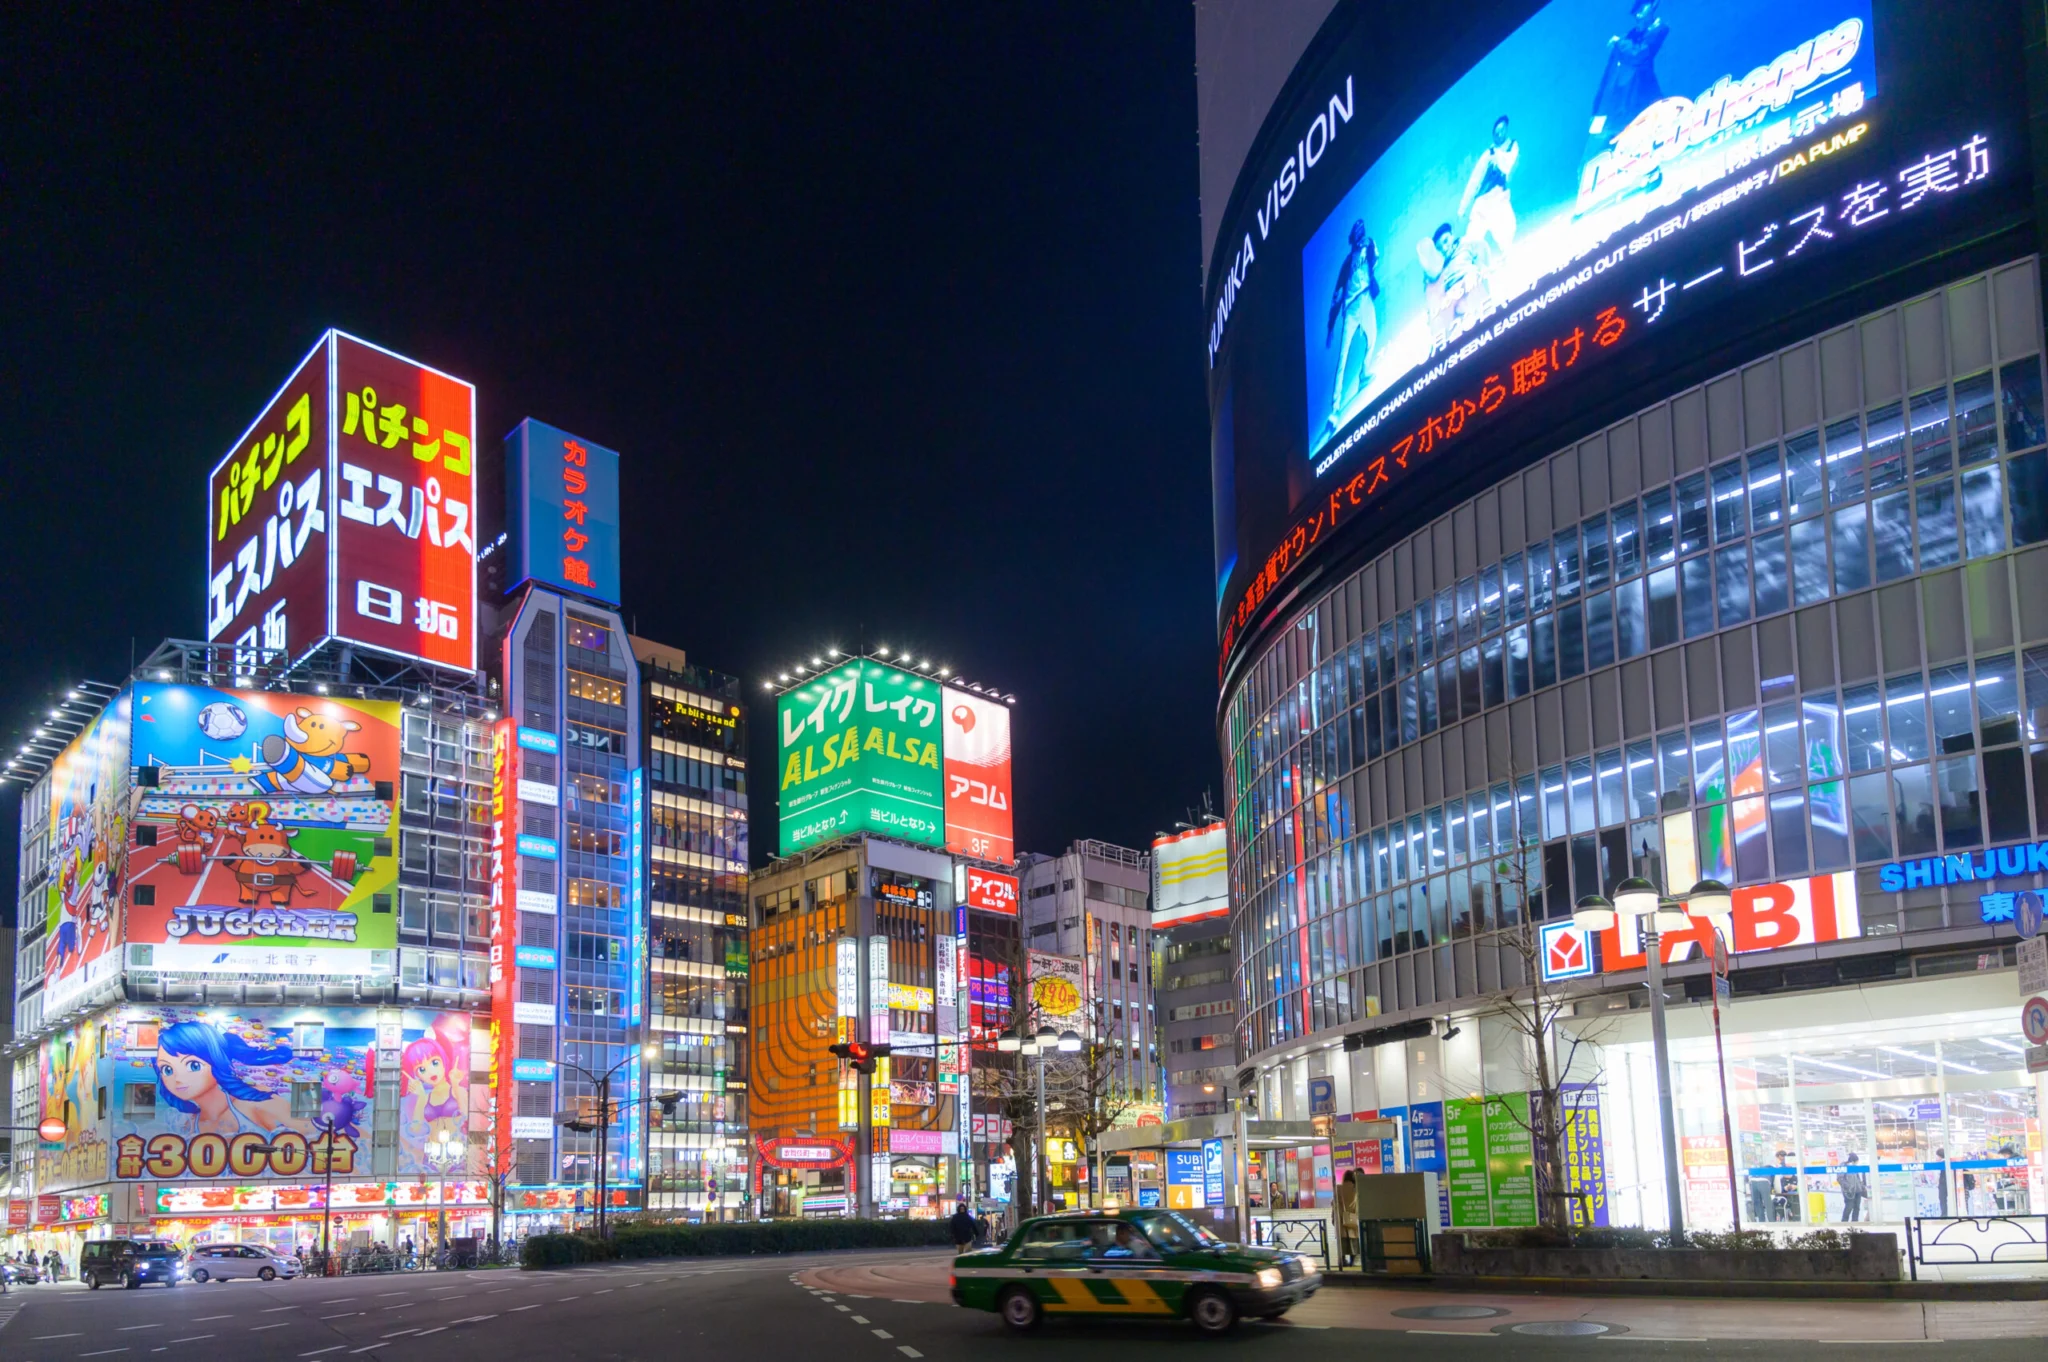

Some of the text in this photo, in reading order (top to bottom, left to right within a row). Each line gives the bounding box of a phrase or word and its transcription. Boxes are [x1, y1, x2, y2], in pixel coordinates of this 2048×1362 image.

[1593, 249, 1627, 274] OUT
[1808, 122, 1868, 163] PUMP
[1207, 75, 1354, 369] YUNIKA VISION
[342, 386, 471, 476] パチンコ
[218, 392, 311, 541] パチンコ
[340, 463, 473, 554] エスパス
[210, 468, 325, 640] エスパス
[675, 702, 736, 728] Public stand
[783, 679, 857, 748] レイク
[864, 681, 936, 729] レイク
[782, 725, 860, 791] ALSA
[863, 726, 939, 770] ALSA
[493, 731, 506, 816] パチンコ
[949, 774, 1007, 811] アコム
[792, 817, 837, 842] 当ビルとなり
[870, 807, 926, 831] 当ビルとなり
[971, 837, 990, 854] 3F
[490, 820, 504, 939] エスパス
[969, 875, 1015, 900] アイフル
[166, 905, 358, 942] JUGGLER
[1599, 874, 1842, 973] LABI
[264, 953, 319, 967] 北電子
[971, 982, 1009, 996] PROMISE
[1311, 1080, 1331, 1113] P
[1446, 1105, 1461, 1120] 5F
[1486, 1102, 1502, 1117] 6F
[972, 1118, 1013, 1134] アコム
[1411, 1109, 1424, 1124] 4F
[1411, 1127, 1434, 1137] エアコン
[1206, 1148, 1215, 1171] P
[1175, 1191, 1186, 1207] 4
